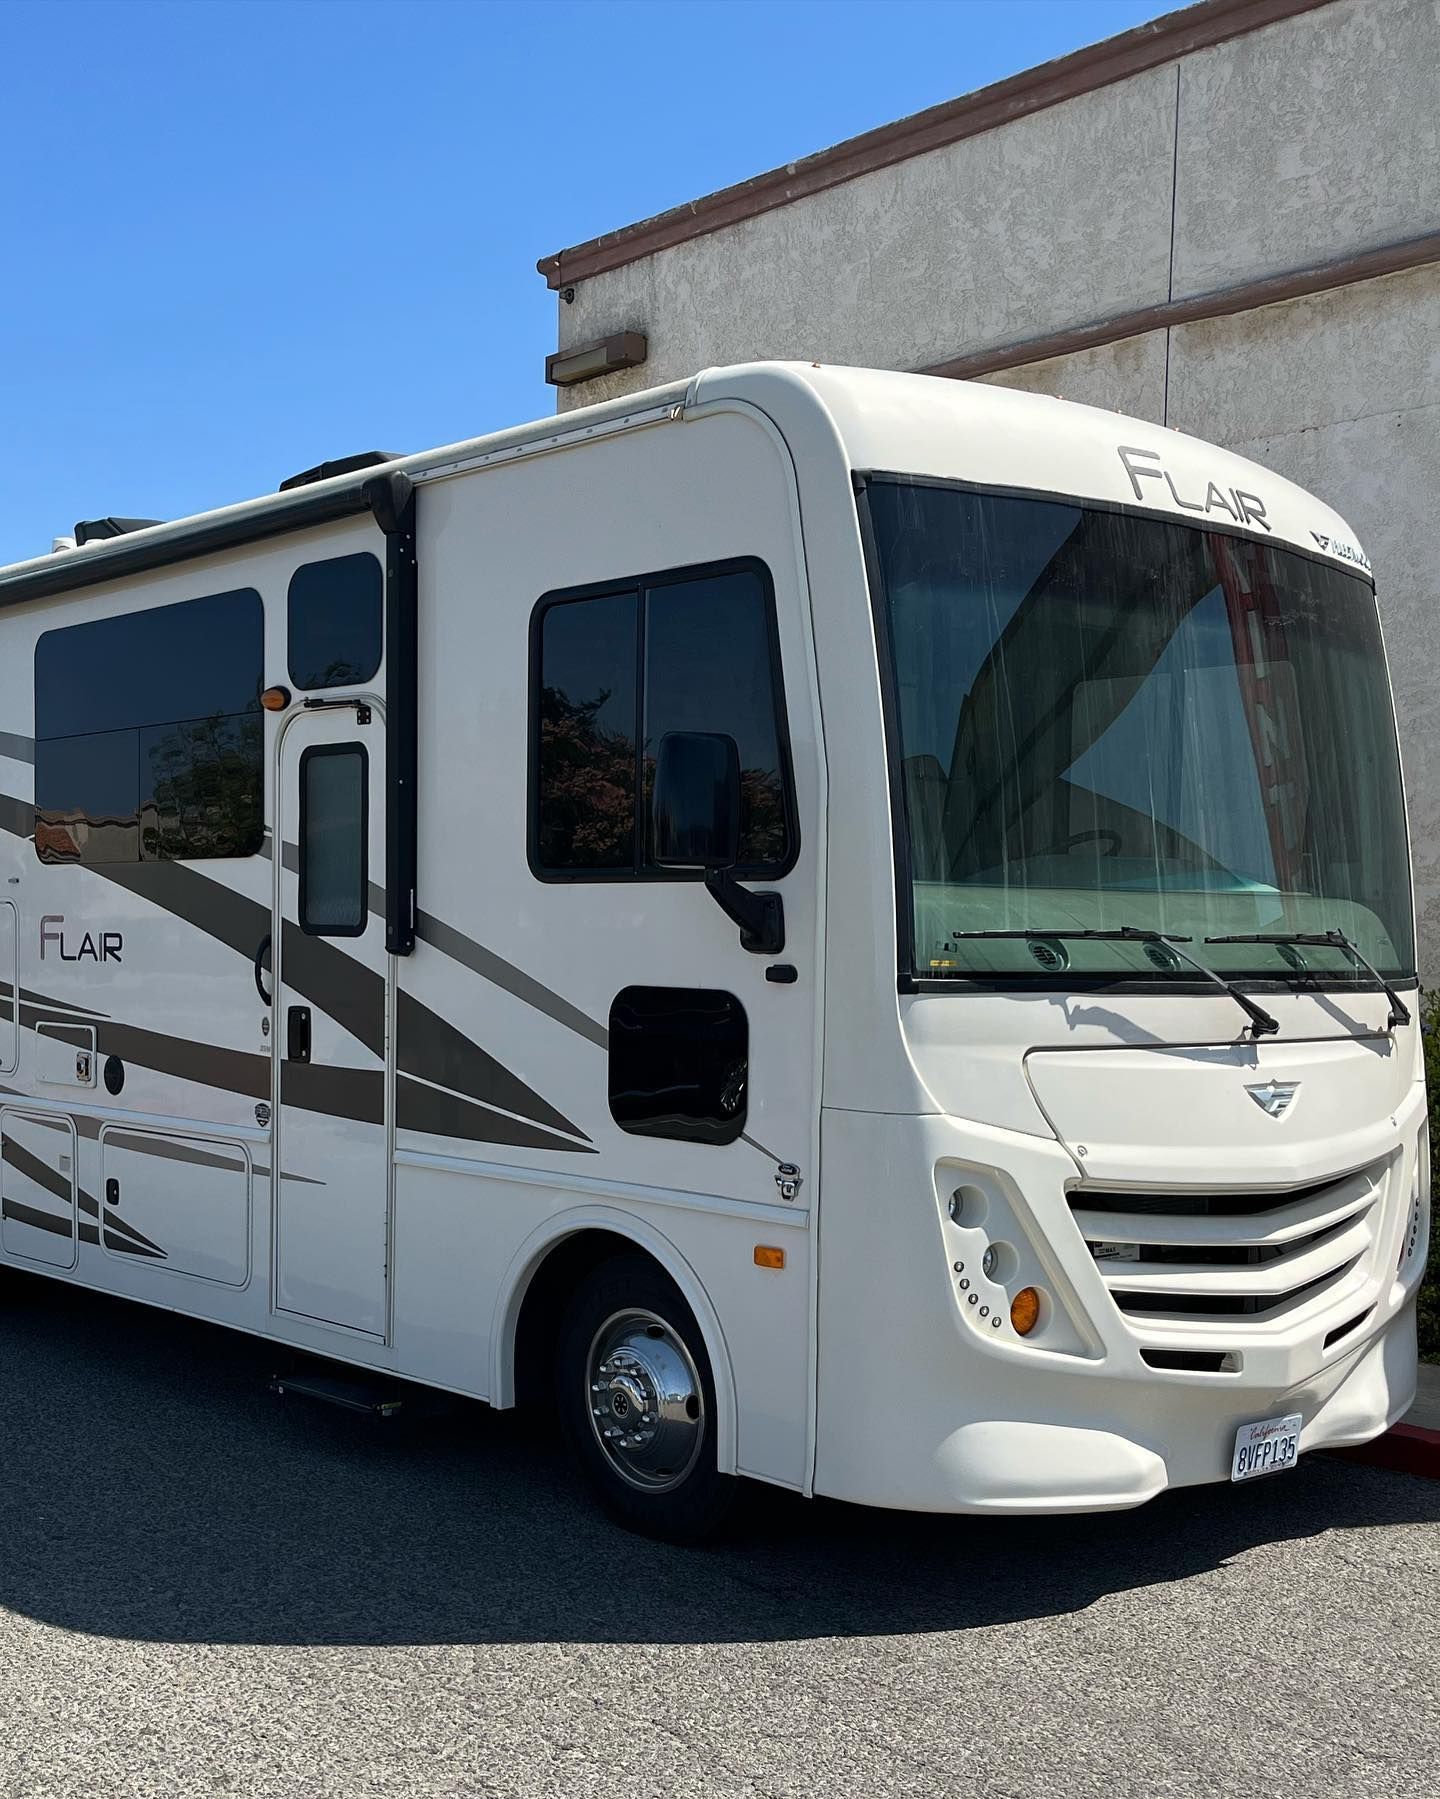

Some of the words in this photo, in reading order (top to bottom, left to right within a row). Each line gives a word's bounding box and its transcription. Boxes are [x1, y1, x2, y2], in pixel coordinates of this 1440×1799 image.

[1117, 445, 1272, 532] FLAIR
[40, 915, 124, 963] FLAIR
[1239, 1435, 1296, 1472] 8VFP135
